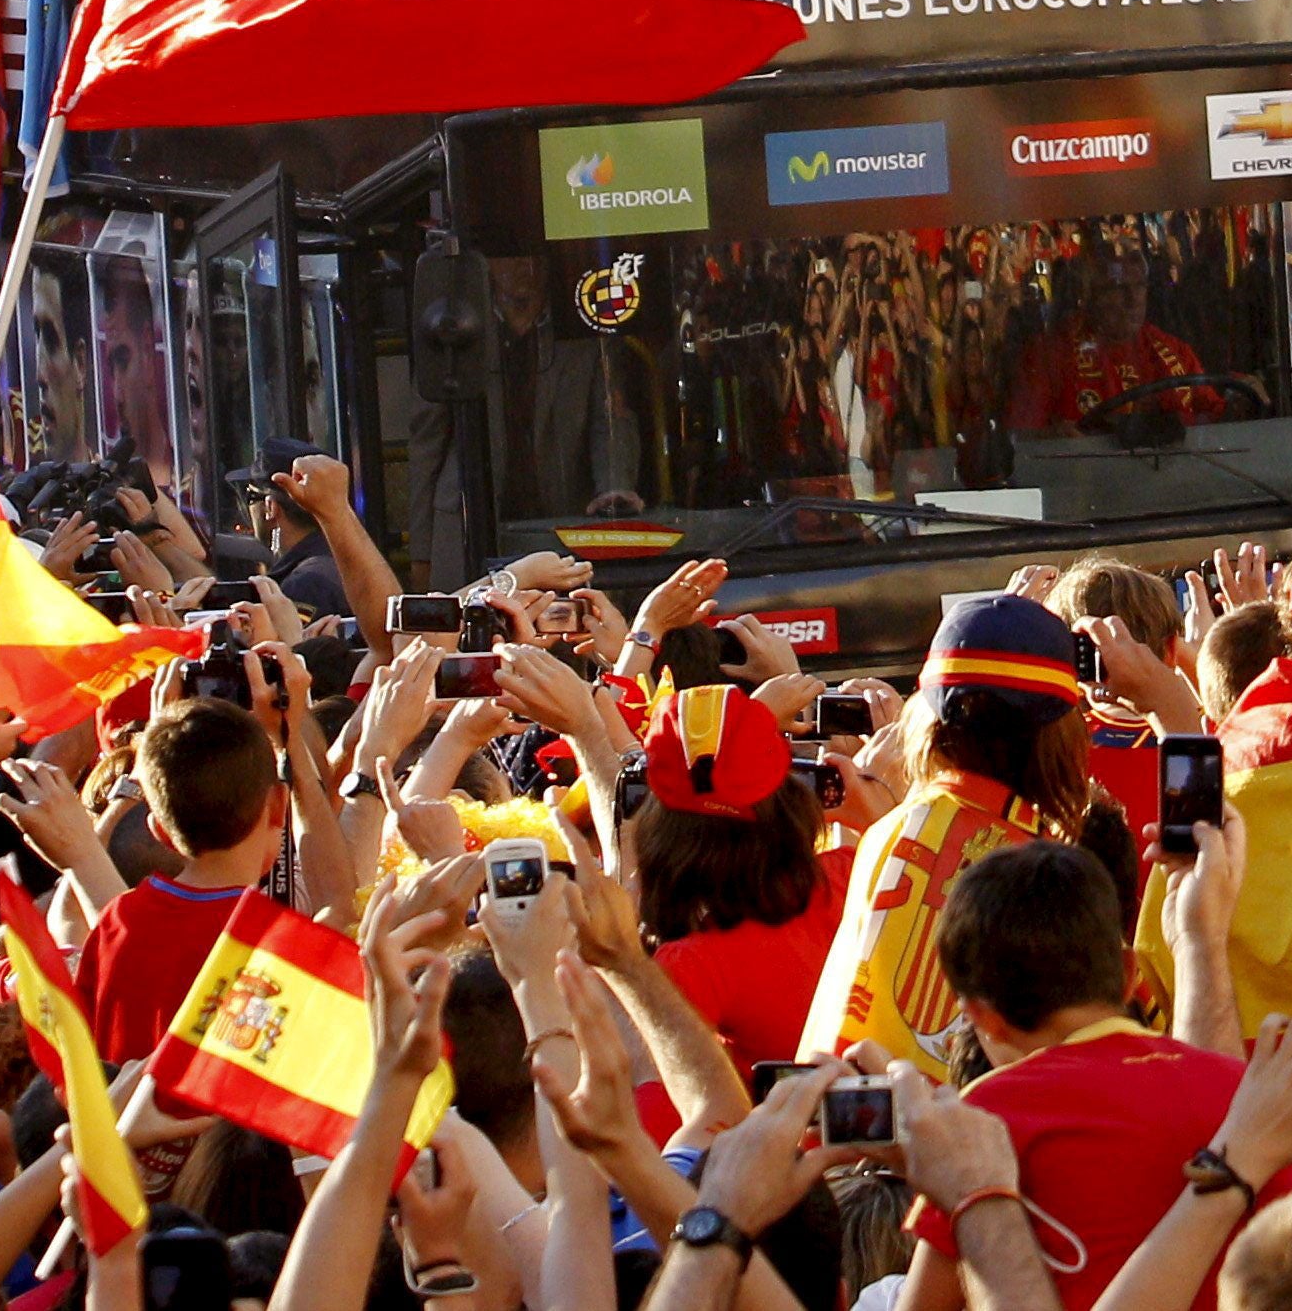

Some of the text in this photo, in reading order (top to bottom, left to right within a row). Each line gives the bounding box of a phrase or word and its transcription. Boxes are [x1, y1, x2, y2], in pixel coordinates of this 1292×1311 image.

[1011, 130, 1151, 166] Cruzcampo
[835, 148, 927, 174] movistar
[579, 187, 693, 211] IBERDROLA
[765, 619, 826, 643] PSA
